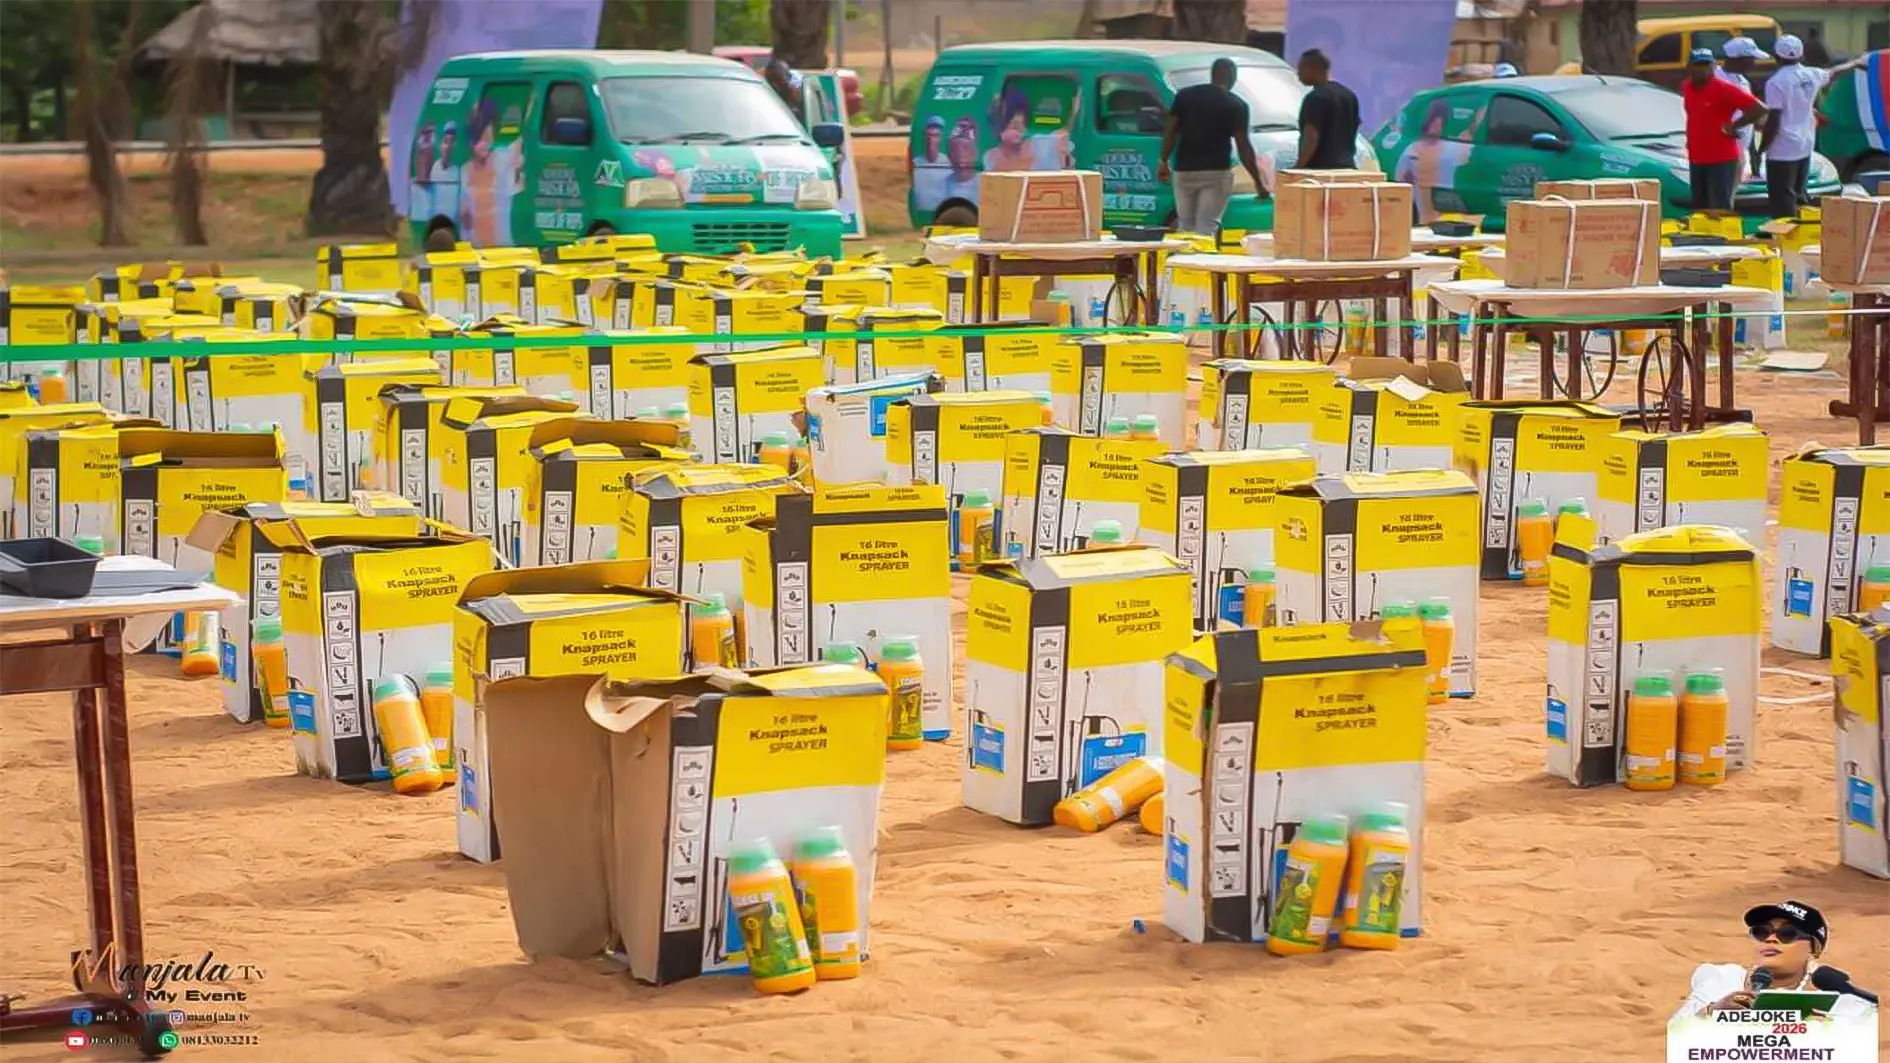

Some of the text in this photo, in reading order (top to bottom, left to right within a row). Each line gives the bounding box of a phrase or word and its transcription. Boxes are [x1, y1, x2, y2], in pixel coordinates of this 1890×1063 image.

[1382, 522, 1443, 534] Knapsack
[860, 540, 898, 550] 16 litre
[840, 550, 909, 562] Knapsack
[859, 561, 909, 572] SPRAYER
[387, 574, 455, 589] Knapsack
[408, 585, 458, 599] SPRAYER
[1647, 586, 1715, 598] Knapsack
[1097, 608, 1160, 623] Knapsack
[582, 629, 624, 640] 16 litre
[562, 638, 636, 655] Knapsack
[582, 652, 637, 666] SPRAYER
[1294, 703, 1376, 719] Knapsack
[1315, 717, 1377, 732] SPRAYER
[749, 724, 827, 740] Knapsack
[769, 739, 827, 753] SPRAYER
